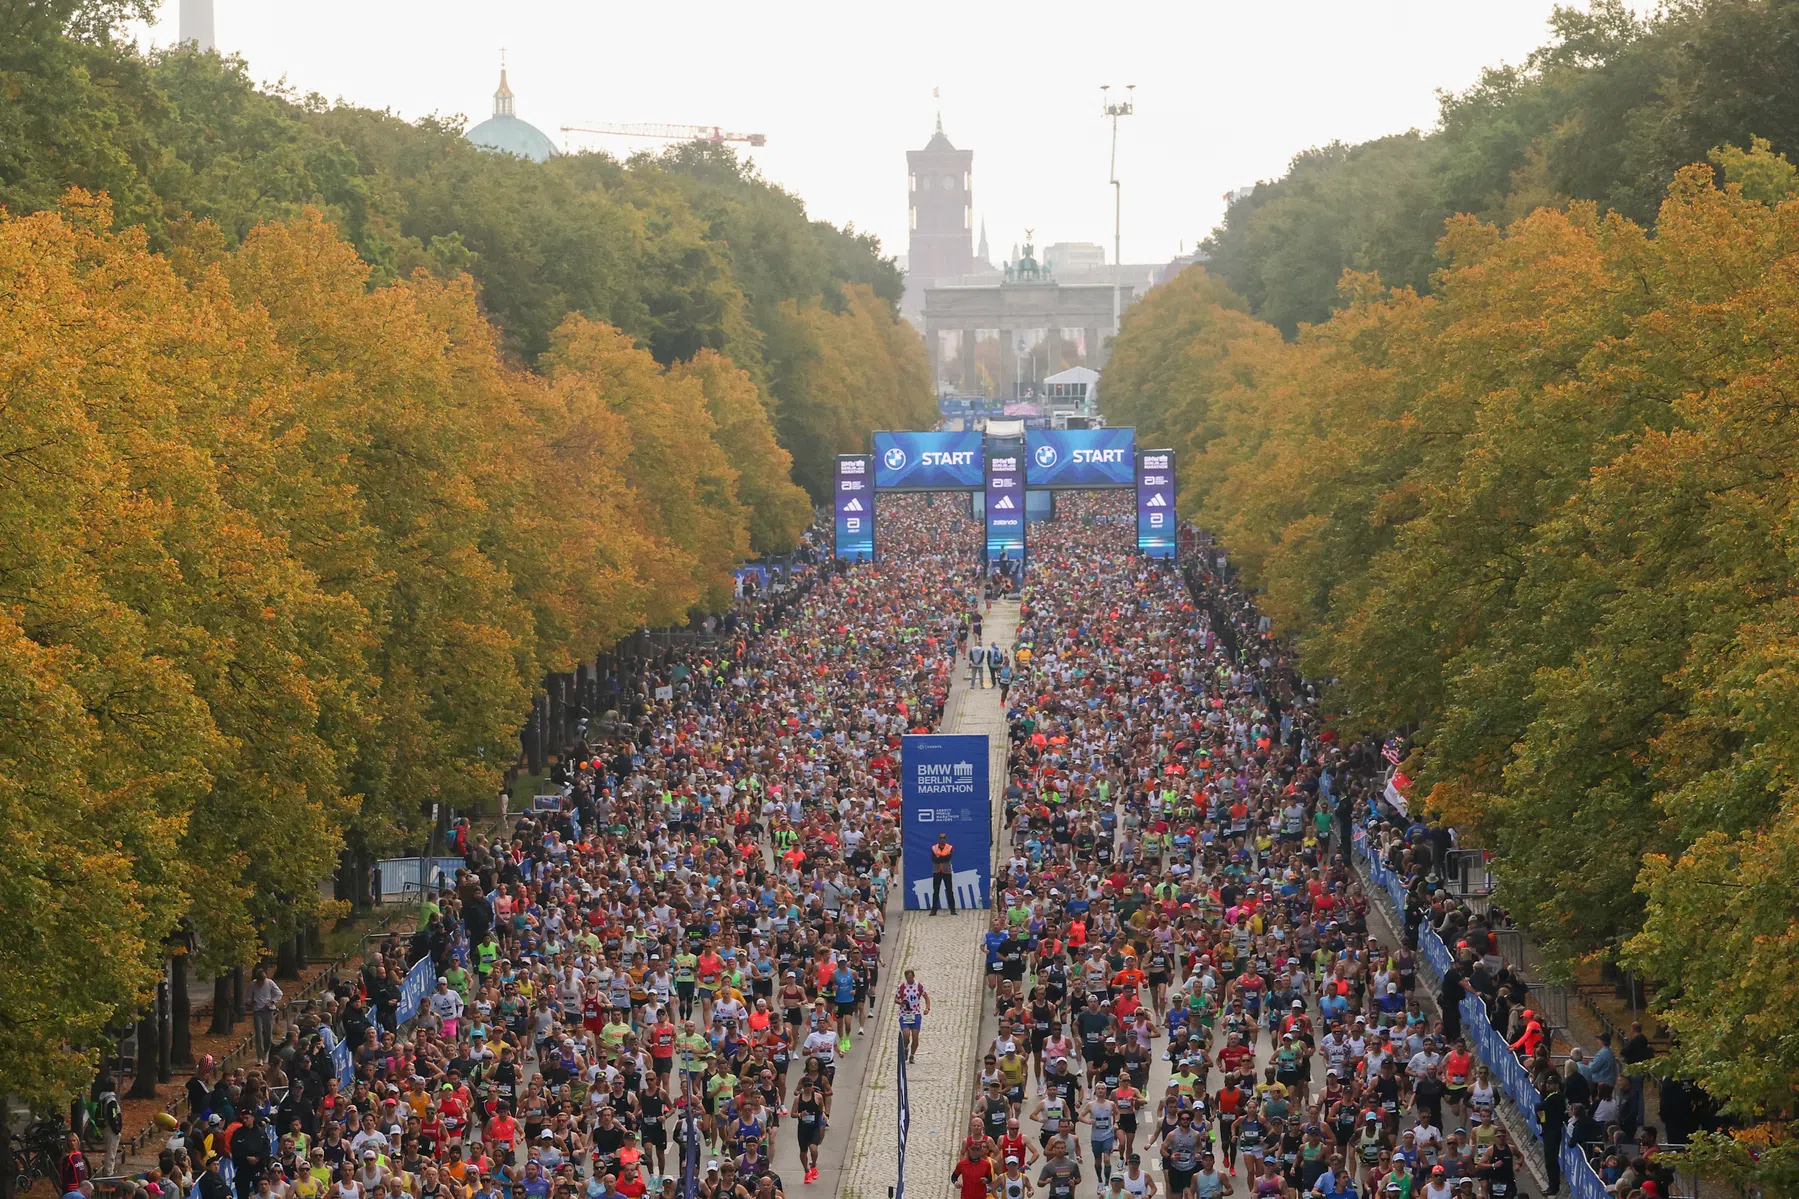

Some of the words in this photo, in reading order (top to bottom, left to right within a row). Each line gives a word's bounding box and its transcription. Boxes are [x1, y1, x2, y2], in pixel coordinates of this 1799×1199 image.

[921, 451, 974, 466] START
[1072, 449, 1125, 463] START
[917, 764, 952, 775] BMW
[918, 776, 952, 784] BERLIN
[918, 785, 973, 793] MARATHON
